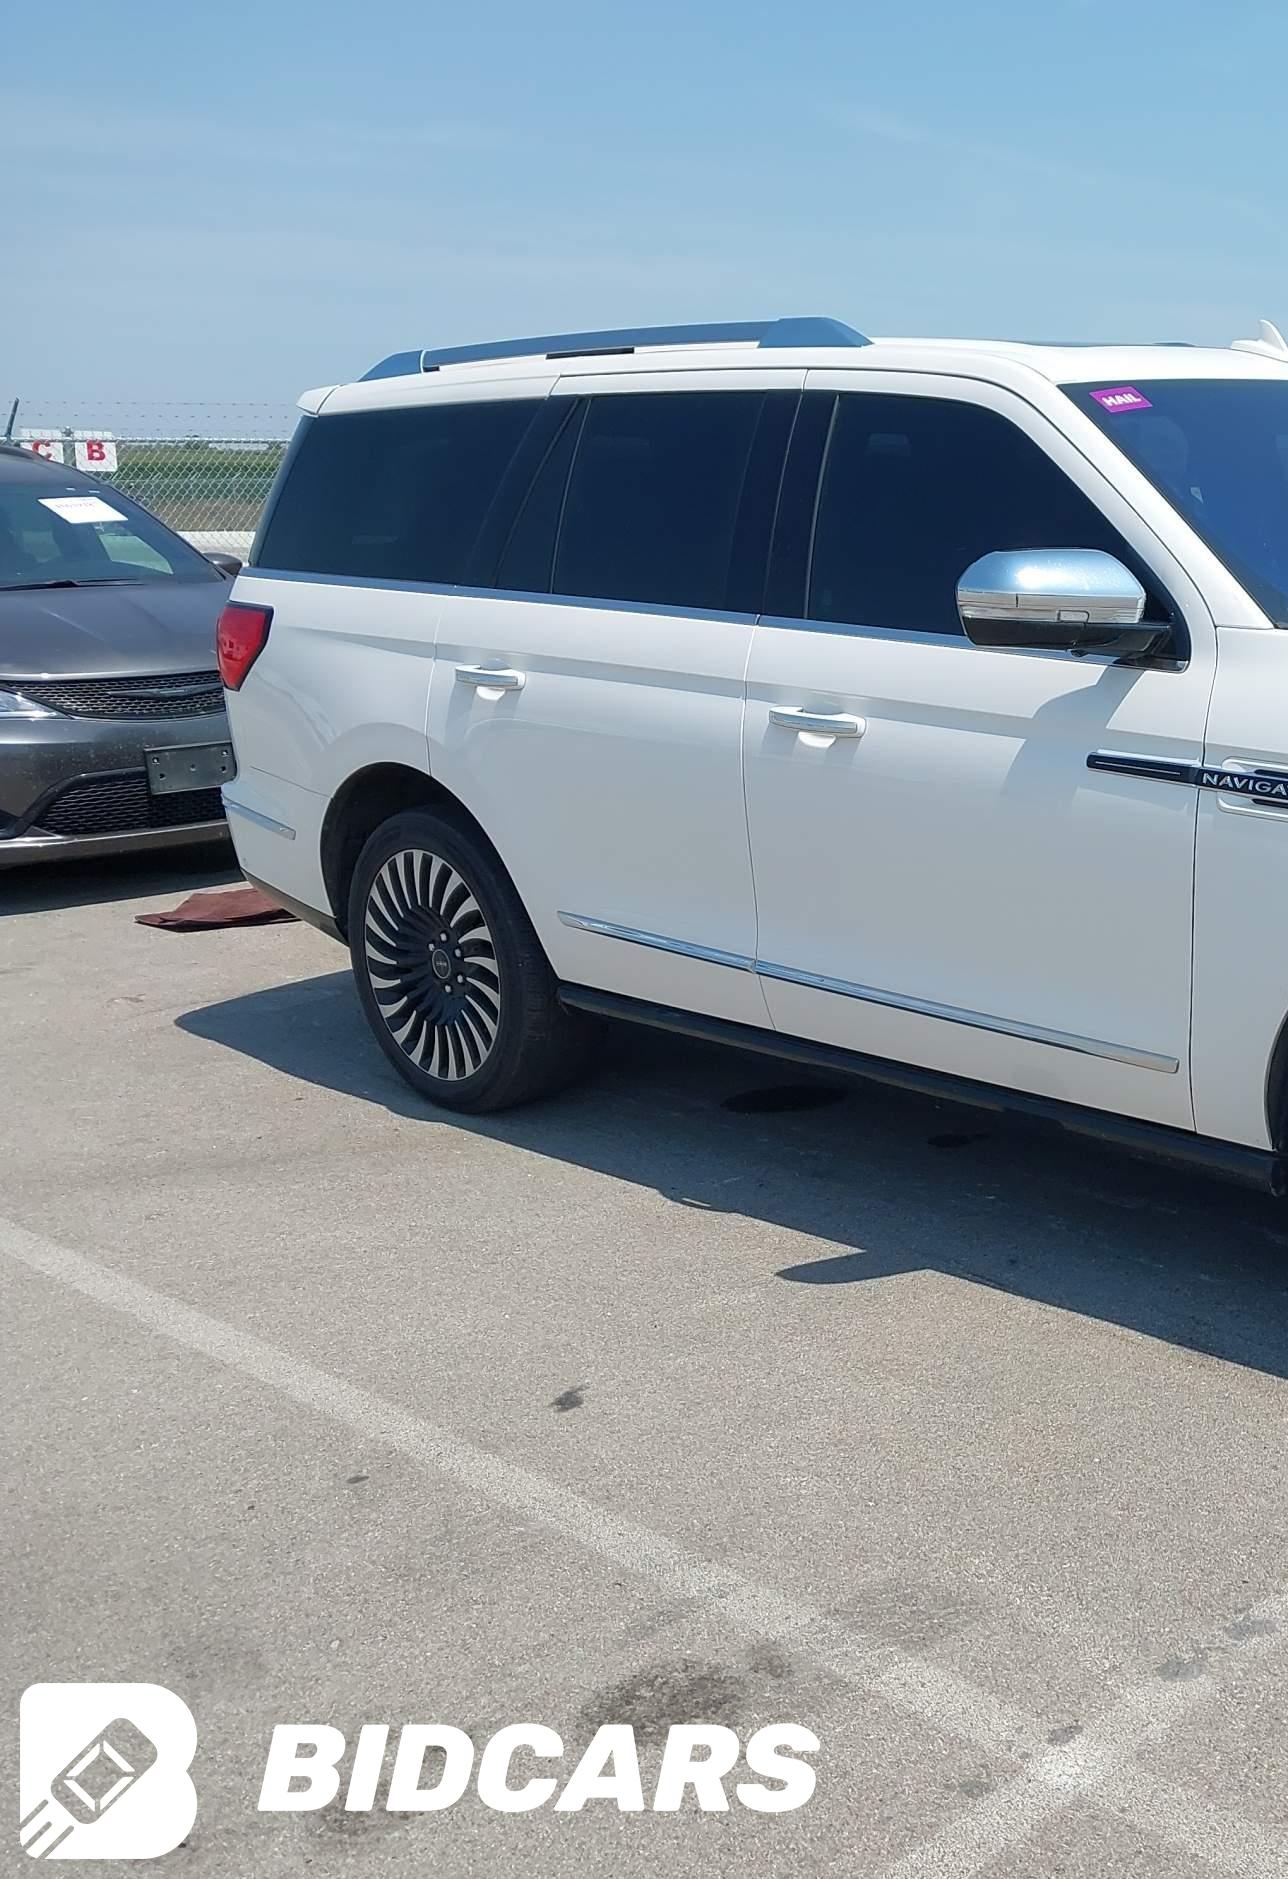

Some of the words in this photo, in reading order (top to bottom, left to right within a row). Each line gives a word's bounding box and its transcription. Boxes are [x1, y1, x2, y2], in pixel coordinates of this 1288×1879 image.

[1101, 393, 1142, 407] HAIL
[32, 439, 51, 460] C
[86, 439, 106, 461] B
